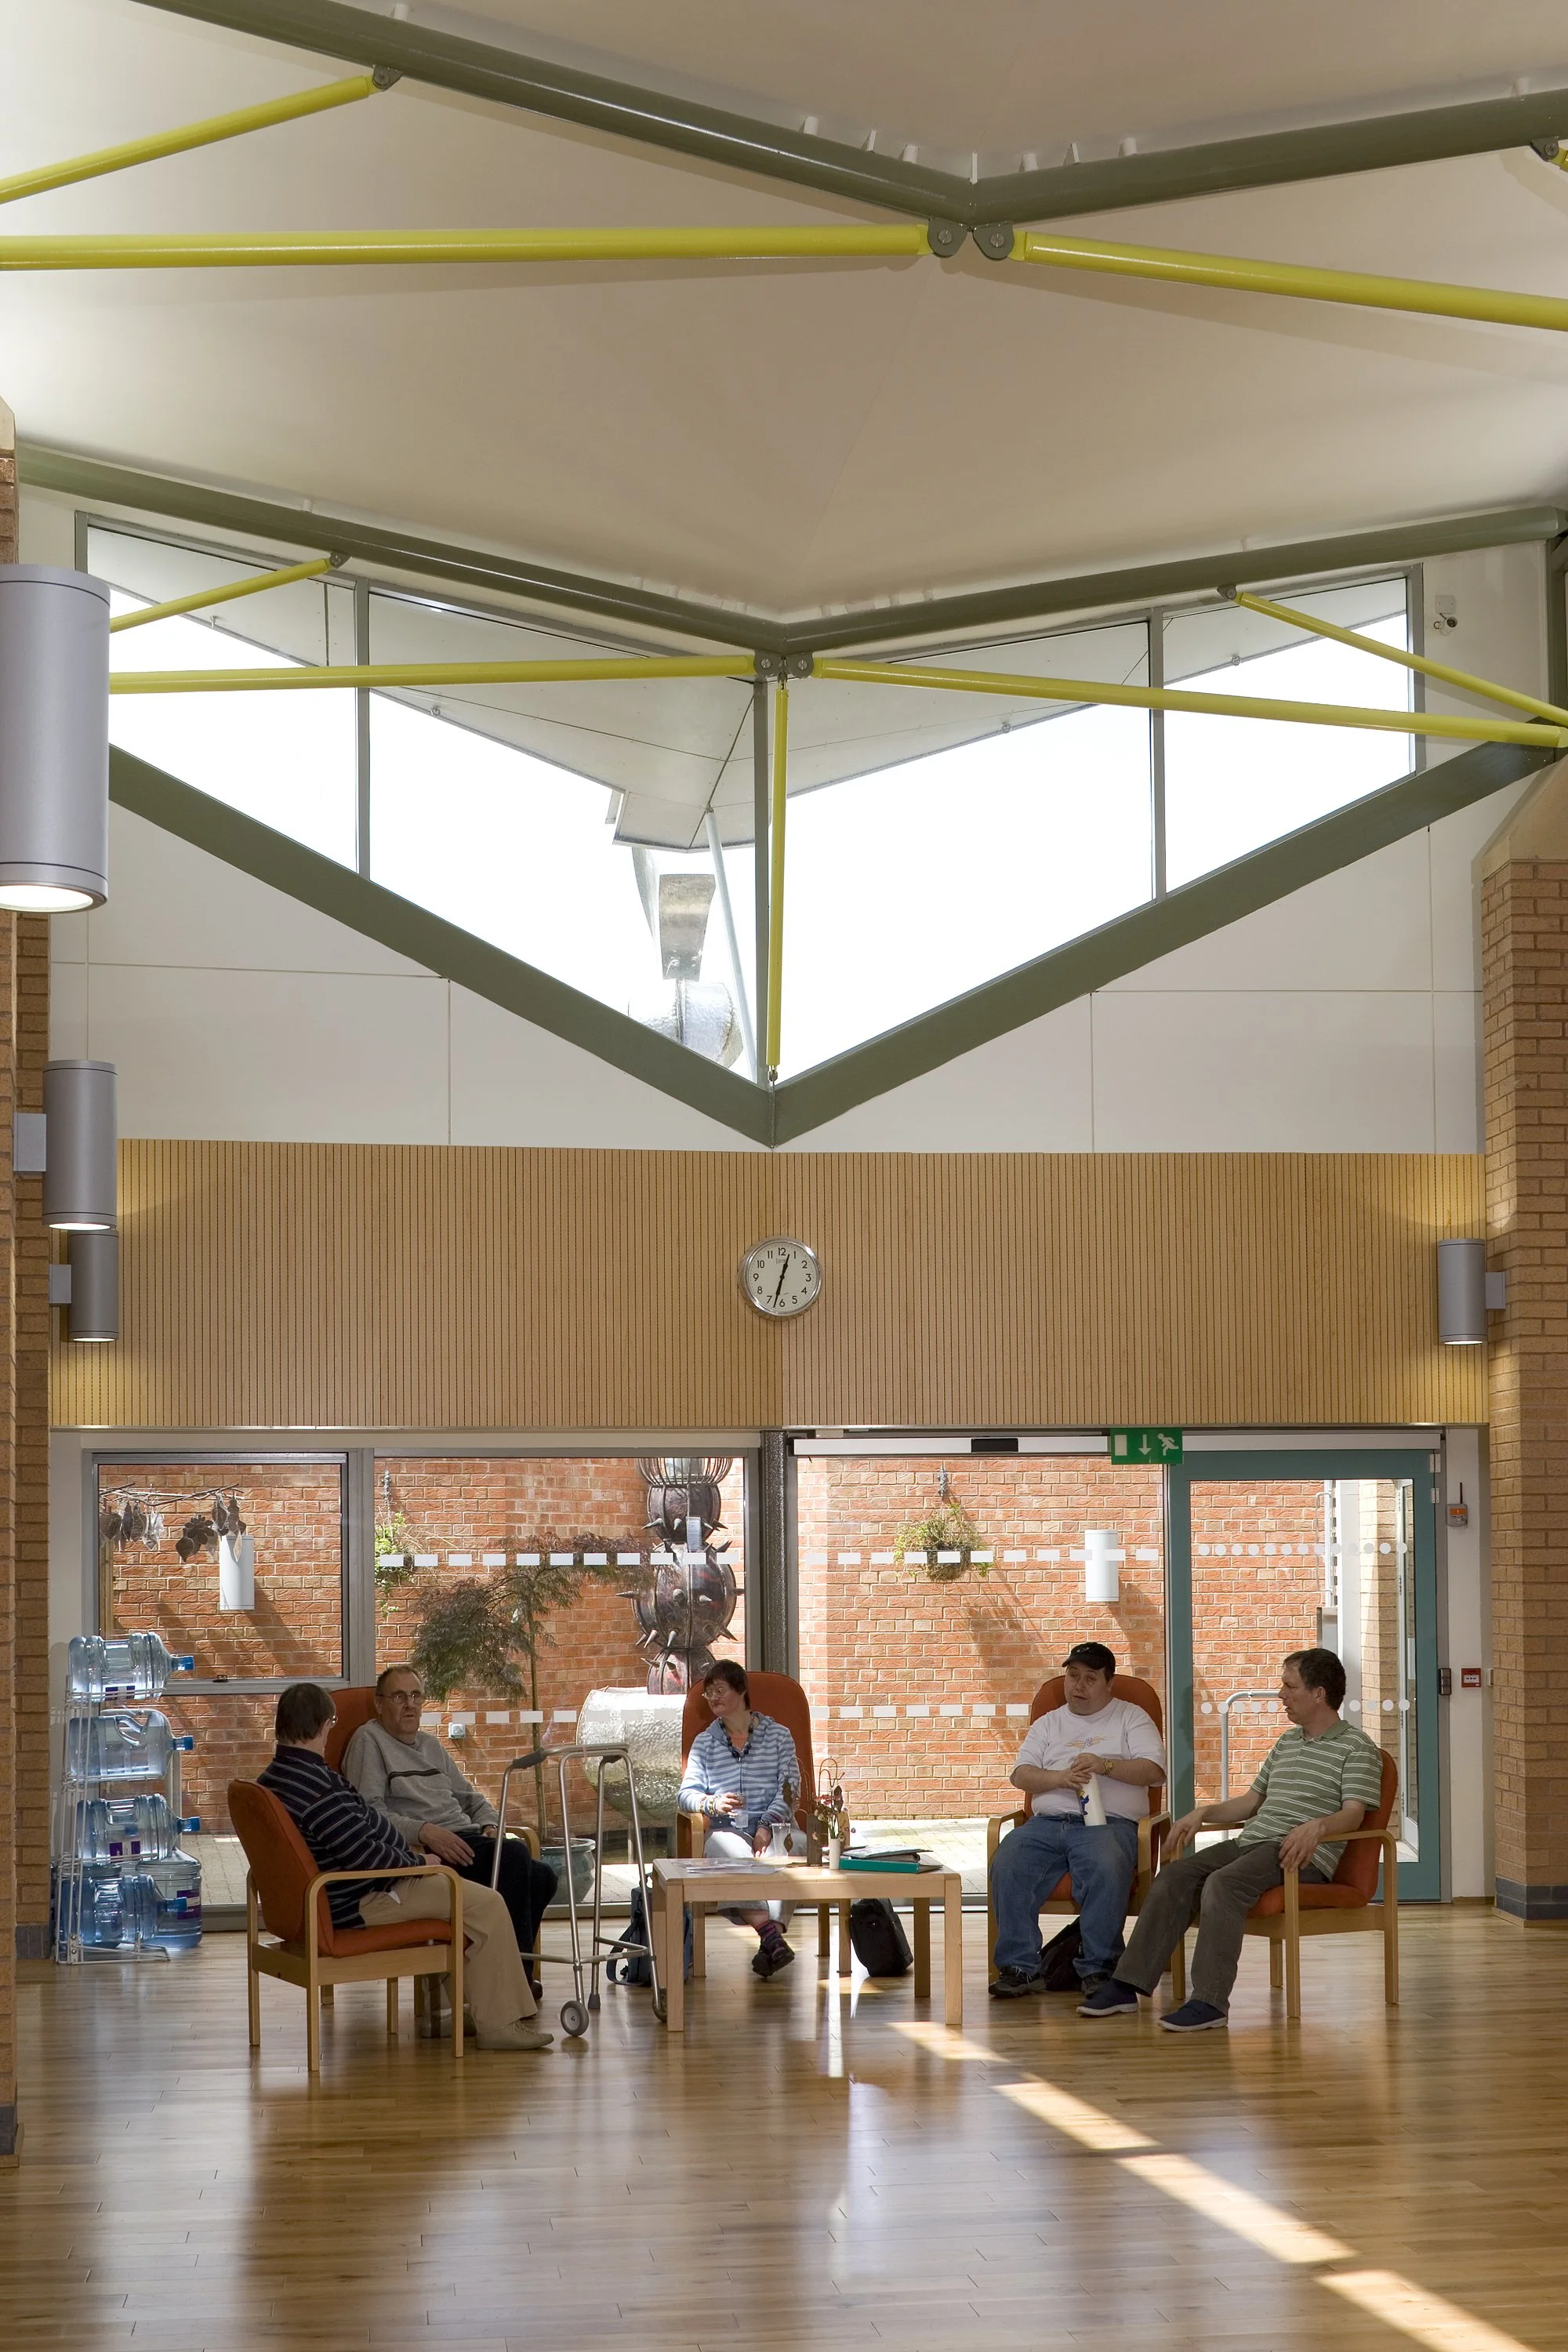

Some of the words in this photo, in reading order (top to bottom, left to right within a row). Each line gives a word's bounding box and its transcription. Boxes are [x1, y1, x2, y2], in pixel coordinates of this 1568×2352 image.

[778, 1247, 786, 1256] 12
[793, 1250, 797, 1259] 1
[757, 1260, 765, 1269] 10
[801, 1260, 808, 1269] 2
[805, 1273, 811, 1282] 3
[757, 1286, 763, 1294] 8
[767, 1295, 772, 1304] 7
[779, 1298, 786, 1307] 6
[792, 1295, 798, 1304] 5
